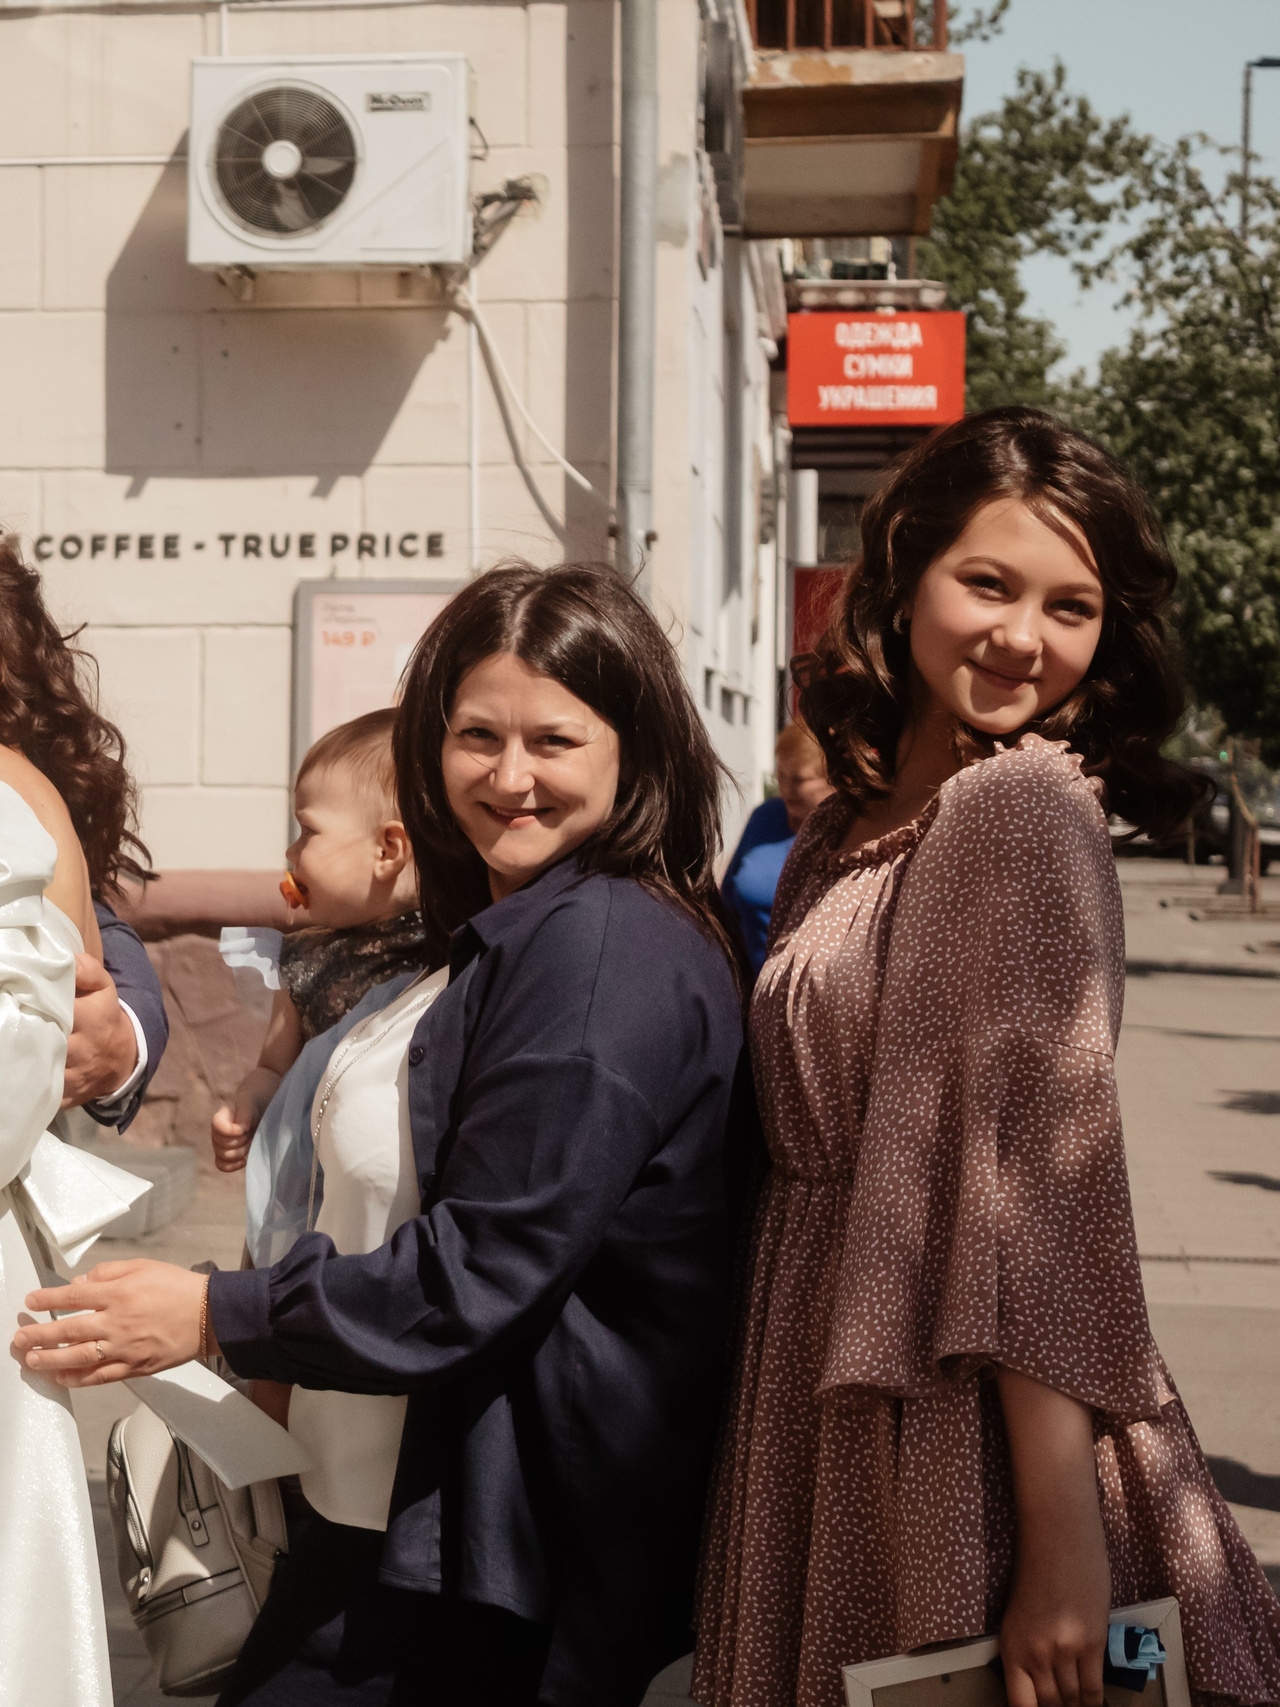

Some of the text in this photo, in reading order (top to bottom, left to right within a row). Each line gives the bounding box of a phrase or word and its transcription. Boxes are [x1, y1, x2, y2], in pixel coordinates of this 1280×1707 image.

[835, 321, 923, 350] ОДЕЖДА
[843, 353, 914, 379] СУМКИ
[818, 384, 938, 411] УКРАШЕНИЯ
[34, 534, 180, 562] COFFEE
[218, 533, 316, 559] TRUE
[330, 532, 444, 560] PRICE
